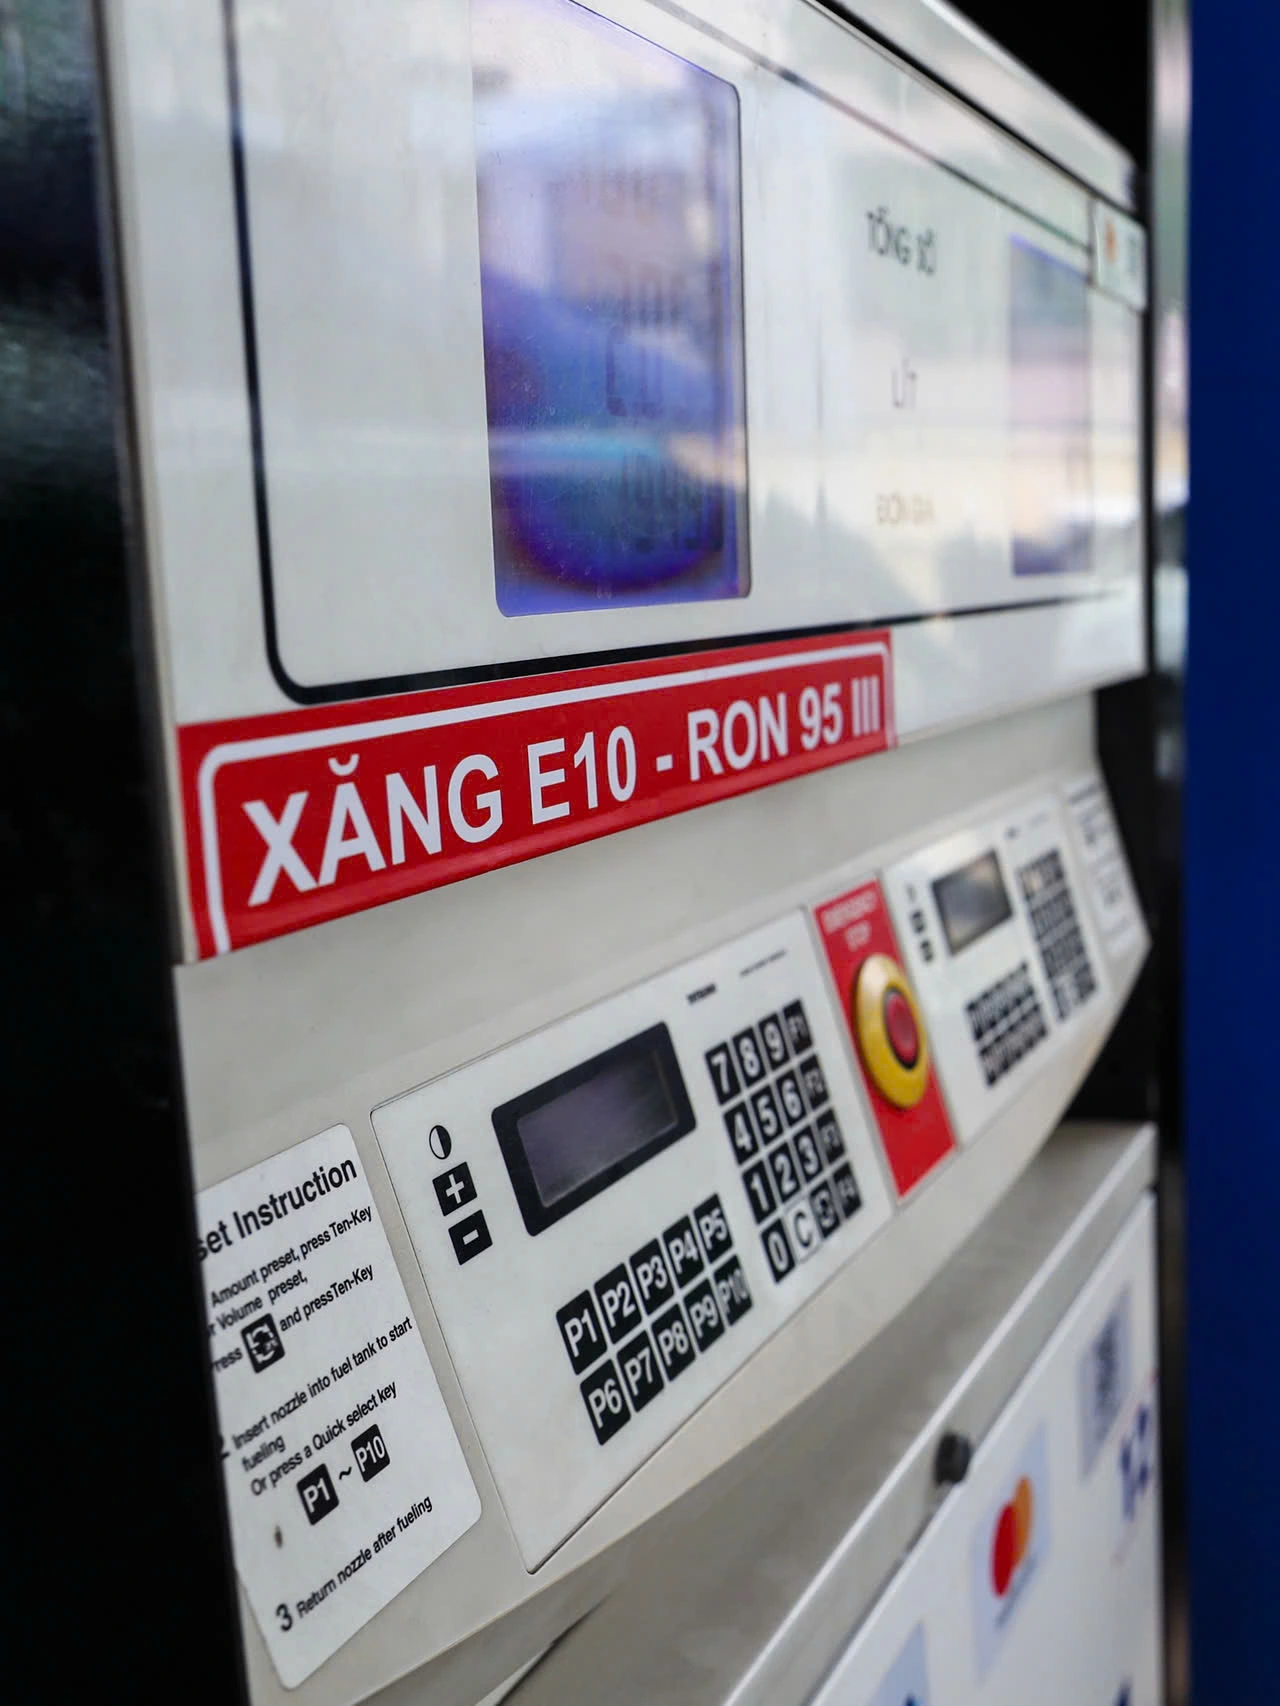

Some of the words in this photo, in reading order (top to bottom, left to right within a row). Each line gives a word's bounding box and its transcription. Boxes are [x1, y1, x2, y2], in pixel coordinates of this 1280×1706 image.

[244, 753, 503, 907] XĂNG
[527, 725, 637, 825] E10
[656, 753, 672, 774] -
[687, 692, 788, 782] RON
[800, 682, 842, 751] 95
[852, 675, 881, 738] III
[711, 1052, 730, 1094] 7
[739, 1037, 761, 1078] 8
[764, 1022, 785, 1062] 9
[734, 1112, 753, 1152] 4
[757, 1094, 778, 1136] 5
[781, 1078, 802, 1119] 6
[232, 1159, 358, 1240] Instruction
[751, 1172, 770, 1213] 1
[774, 1153, 797, 1196] 2
[799, 1135, 820, 1175] 3
[211, 1269, 260, 1308] Amount
[259, 1248, 301, 1284] preset,
[300, 1230, 331, 1260] press
[328, 1206, 373, 1238] Ten-Key
[768, 1231, 790, 1272] 0
[794, 1210, 813, 1248] C
[216, 1296, 264, 1330] Volume
[267, 1270, 308, 1306] preset,
[564, 1308, 598, 1358] P1
[601, 1280, 636, 1328] P2
[636, 1255, 668, 1300] P3
[668, 1231, 698, 1274] P4
[699, 1208, 728, 1250] P5
[211, 1347, 244, 1373] ress
[279, 1307, 302, 1332] and
[588, 1378, 623, 1429] P6
[624, 1347, 654, 1396] P7
[657, 1320, 689, 1366] P8
[690, 1293, 719, 1339] P9
[717, 1268, 750, 1315] P10
[232, 1415, 270, 1450] Insert
[270, 1391, 308, 1425] nozzle
[307, 1375, 331, 1399] into
[330, 1357, 353, 1383] fuel
[352, 1342, 378, 1367] tank
[376, 1334, 389, 1351] to
[389, 1316, 413, 1342] start
[241, 1435, 286, 1472] fueling
[250, 1475, 268, 1497] Or
[268, 1451, 304, 1487] press
[303, 1445, 314, 1459] a
[312, 1419, 347, 1451] Quick
[346, 1394, 379, 1427] select
[377, 1380, 397, 1406] key
[303, 1478, 331, 1513] P1
[355, 1435, 386, 1473] P10
[275, 1603, 294, 1632] 3
[296, 1577, 338, 1619] Return
[337, 1547, 373, 1586] nozzle
[372, 1525, 398, 1554] after
[396, 1496, 434, 1534] fueling
